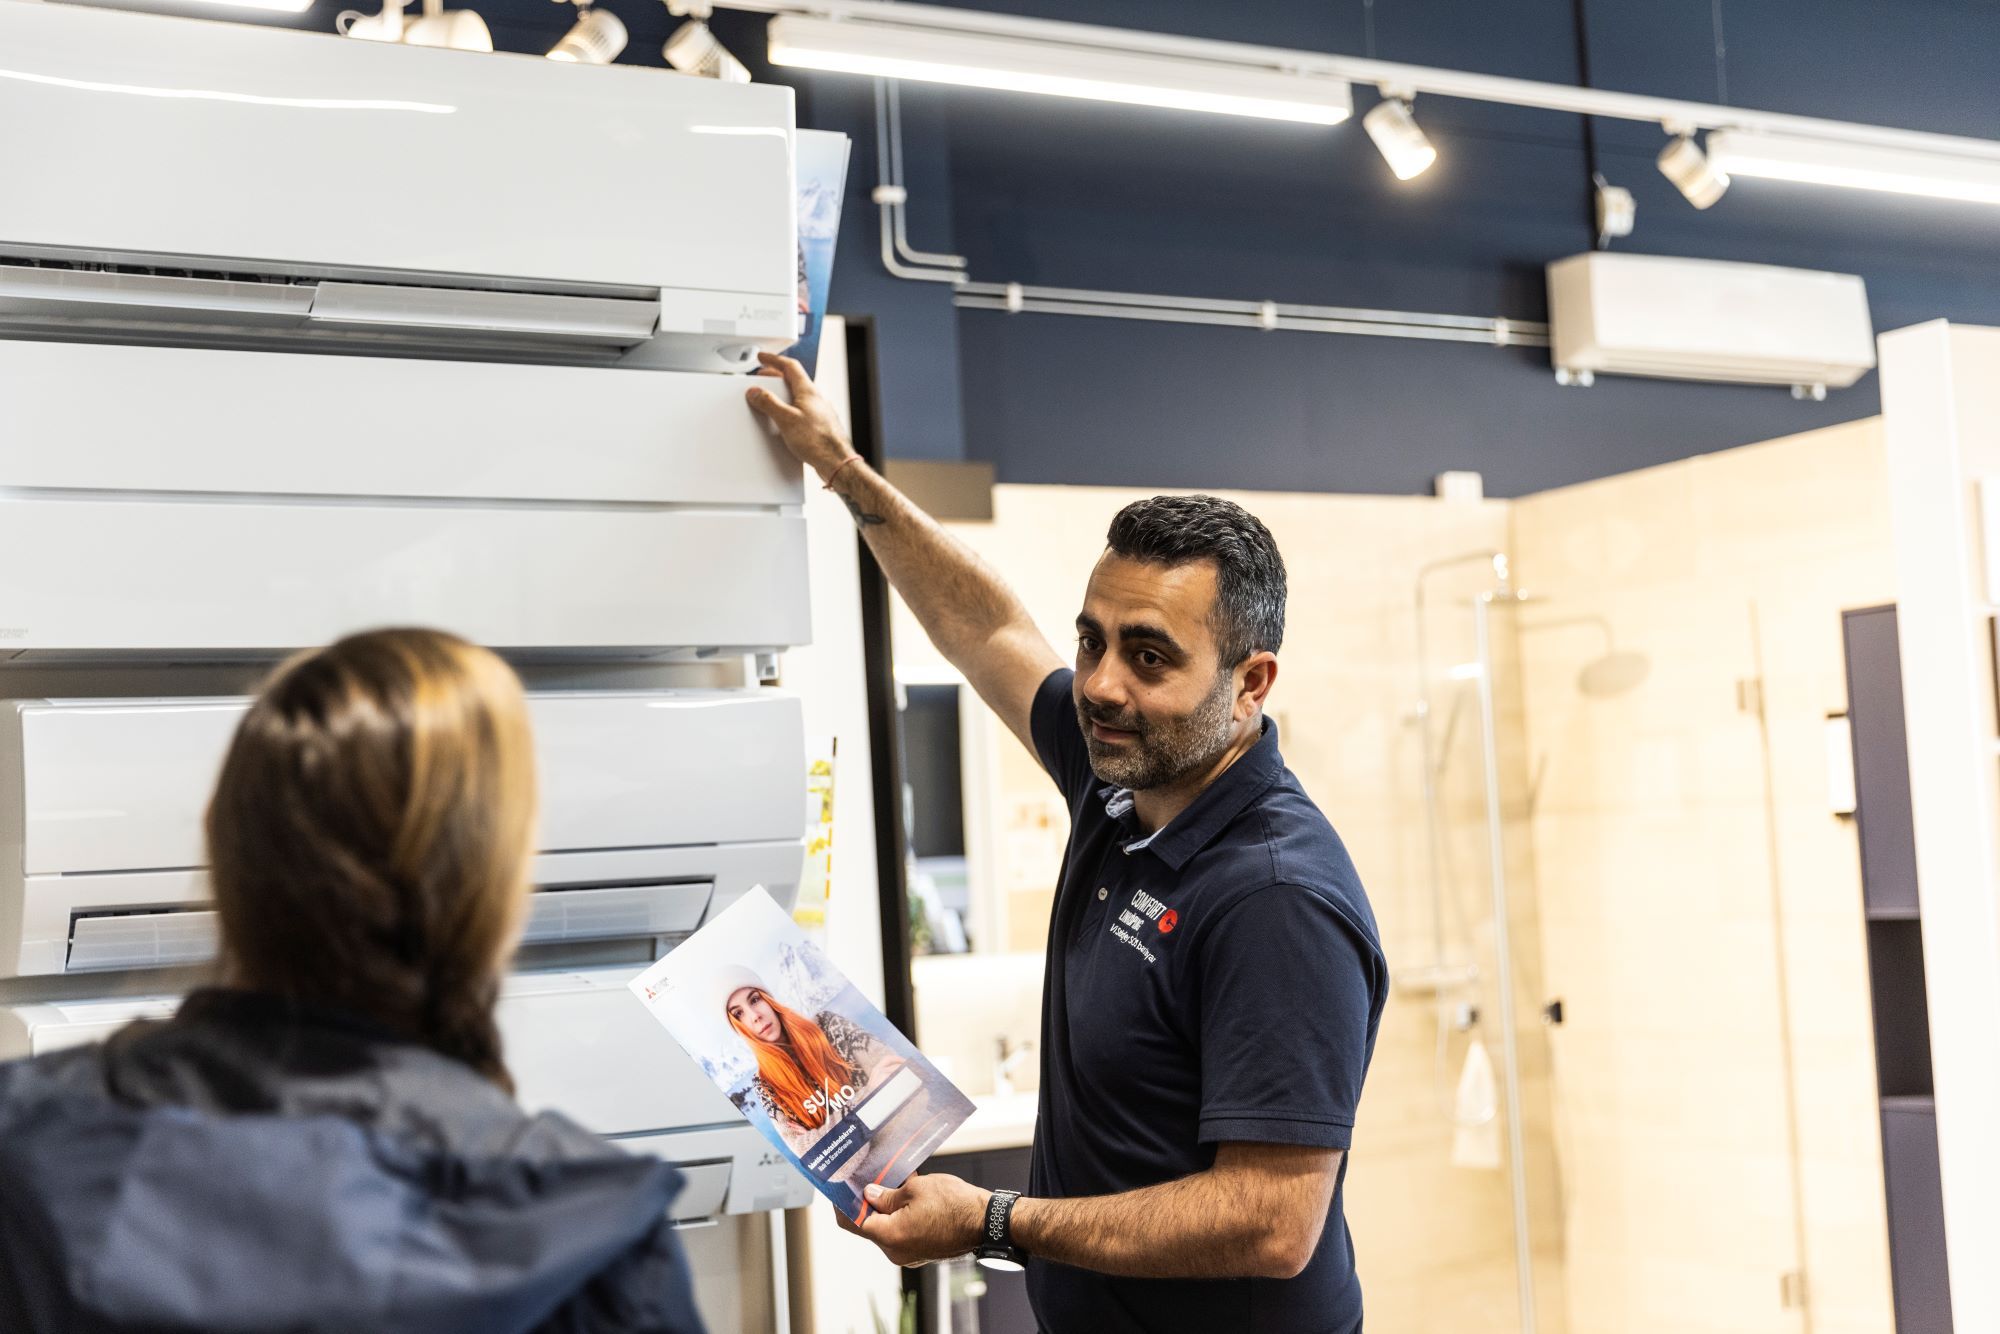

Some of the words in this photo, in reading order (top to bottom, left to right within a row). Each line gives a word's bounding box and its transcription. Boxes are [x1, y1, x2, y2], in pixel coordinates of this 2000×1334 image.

[1131, 889, 1167, 920] COMFORT
[822, 1124, 856, 1156] Motståndskraft
[829, 1139, 853, 1161] Scandinavia
